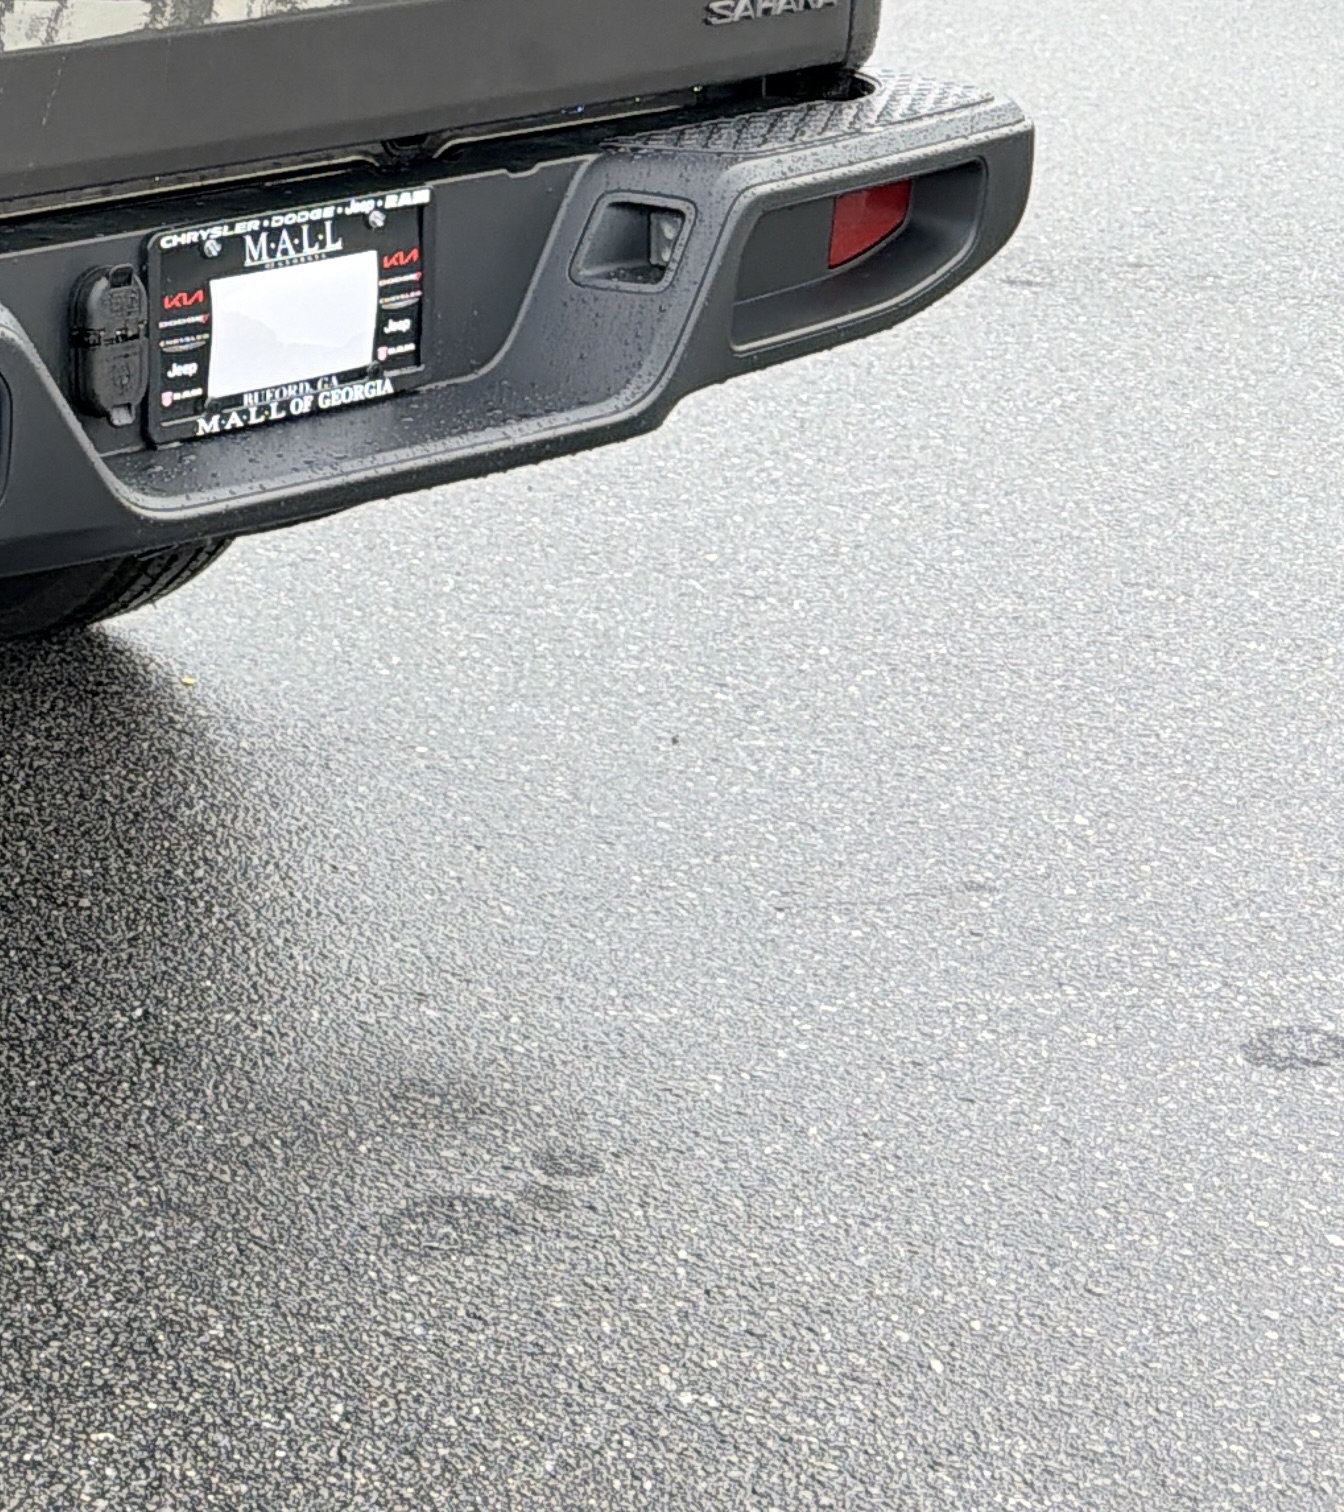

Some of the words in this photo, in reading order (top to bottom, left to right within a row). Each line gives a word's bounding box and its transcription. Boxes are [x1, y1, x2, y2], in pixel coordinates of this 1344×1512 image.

[160, 219, 260, 249] CHRYSLER
[270, 205, 335, 228] DODGE
[385, 188, 431, 210] RAM
[383, 247, 419, 269] KIA
[162, 289, 204, 310] KIA
[383, 317, 412, 334] Jeep
[166, 361, 199, 378] Jeep
[290, 395, 314, 416] OF
[318, 378, 394, 409] GEORGIA
